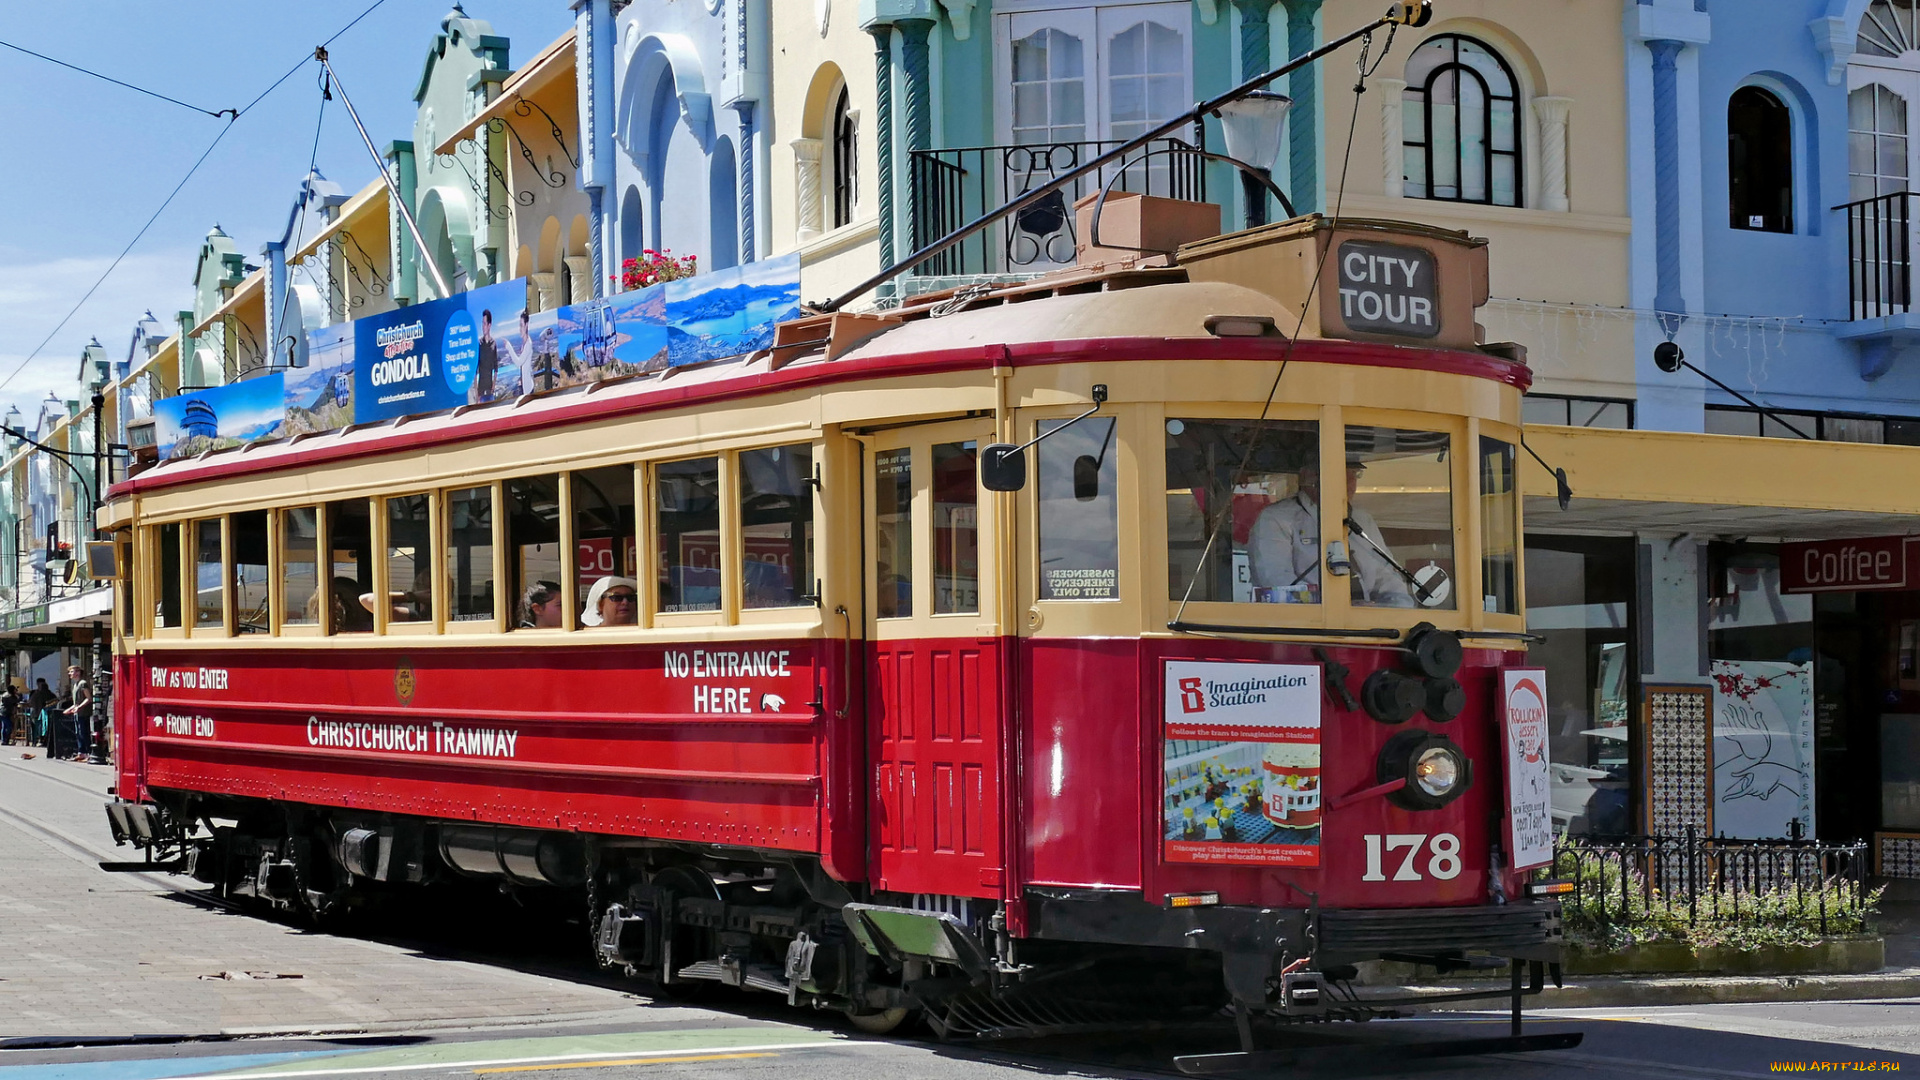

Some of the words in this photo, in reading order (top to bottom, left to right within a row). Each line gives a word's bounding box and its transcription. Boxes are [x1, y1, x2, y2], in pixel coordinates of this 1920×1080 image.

[1344, 252, 1420, 288] CITY
[1339, 288, 1433, 326] TOUR
[377, 320, 423, 347] Christchurch
[371, 353, 430, 386] GONDOLA
[1804, 546, 1891, 584] Coffee
[152, 666, 168, 687] PAY
[170, 672, 179, 688] AS
[182, 672, 196, 688] YOU
[199, 668, 228, 690] ENTER
[664, 651, 689, 678] NO
[694, 650, 791, 678] ENTRANCE
[694, 685, 752, 713] HERE
[1206, 675, 1307, 695] Imagination
[1210, 692, 1266, 708] Station
[1801, 678, 1809, 748] CHINESE
[166, 713, 192, 736] FRONT
[196, 715, 214, 737] END
[307, 716, 428, 752] CHRISTCHURCH
[432, 721, 518, 757] TRAMWAY
[1240, 731, 1284, 739] Imagination
[1208, 846, 1262, 854] Christchurch's
[1228, 853, 1266, 861] education
[1362, 833, 1462, 881] 178
